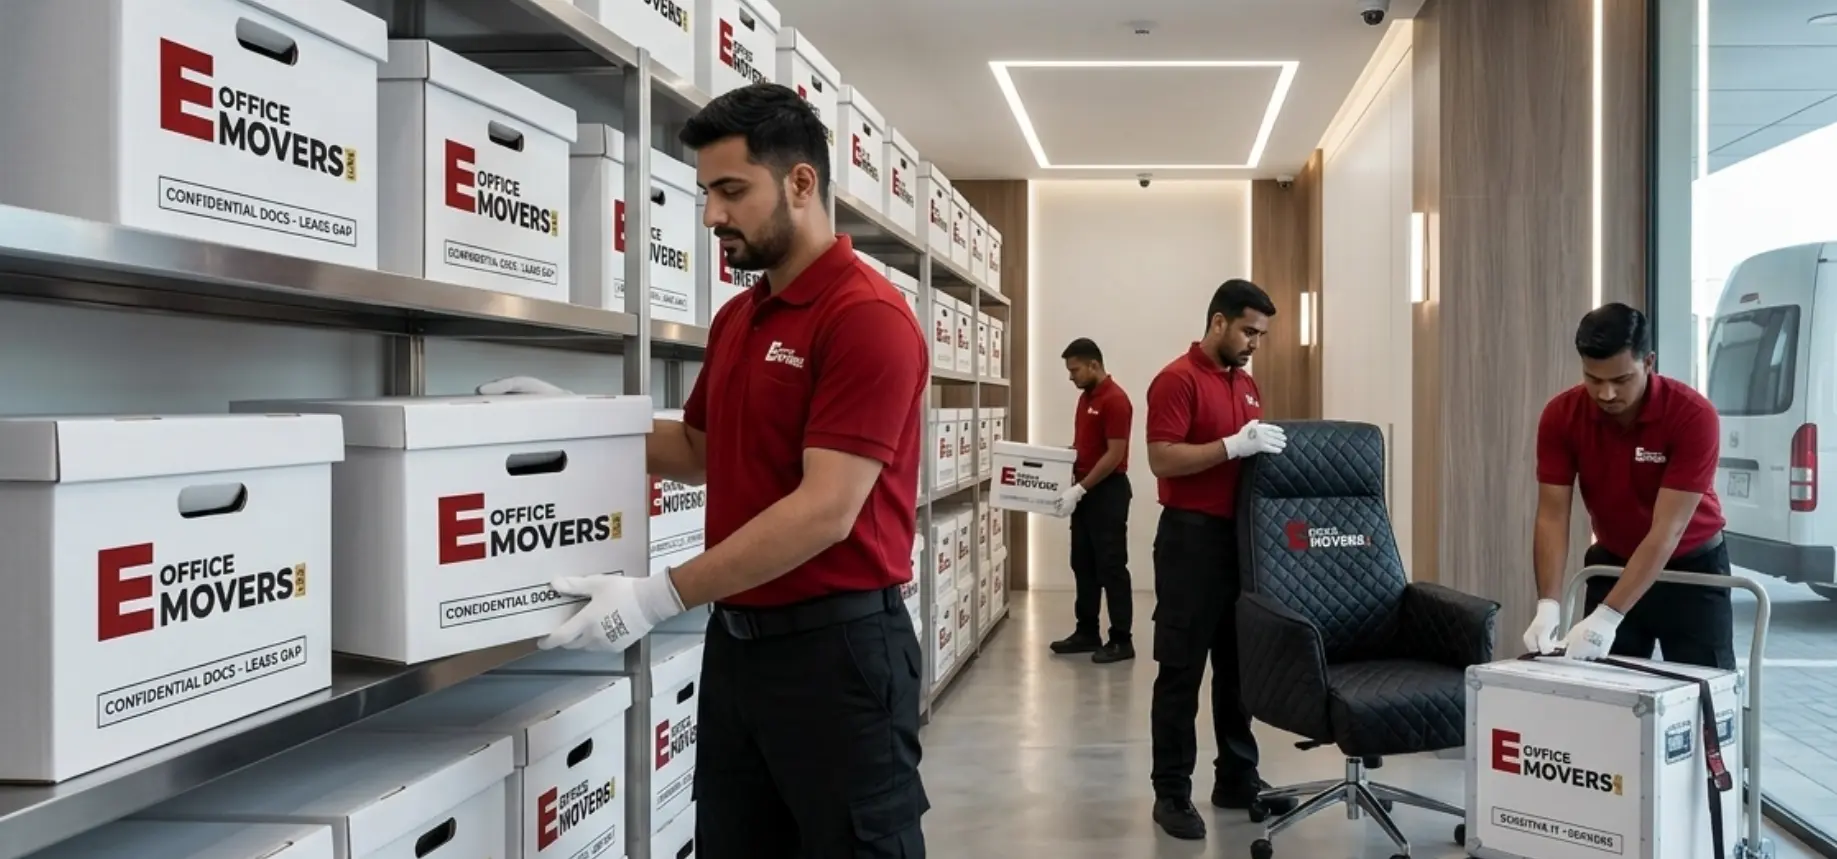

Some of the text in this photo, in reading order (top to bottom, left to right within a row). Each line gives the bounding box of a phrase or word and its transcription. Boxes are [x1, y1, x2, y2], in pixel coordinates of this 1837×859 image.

[719, 17, 733, 68] E
[160, 37, 214, 142] E
[219, 86, 291, 126] OFFICE
[219, 111, 344, 177] MOVERS
[445, 138, 476, 213] E
[166, 187, 257, 218] CONFIDENTIAL
[260, 207, 290, 225] DOCS
[478, 189, 550, 233] MOVERS
[438, 492, 486, 565] E
[490, 503, 556, 526] OFFICE
[491, 515, 610, 557] MOVERS
[98, 542, 154, 642] E
[159, 554, 235, 586] OFFICE
[160, 567, 293, 627] MOVERS
[105, 675, 201, 715] CONFIDENTIAL
[203, 664, 236, 686] DOCS
[655, 718, 670, 771] E
[1492, 728, 1521, 775] E
[1524, 759, 1613, 792] MOVERS
[537, 786, 558, 852] E
